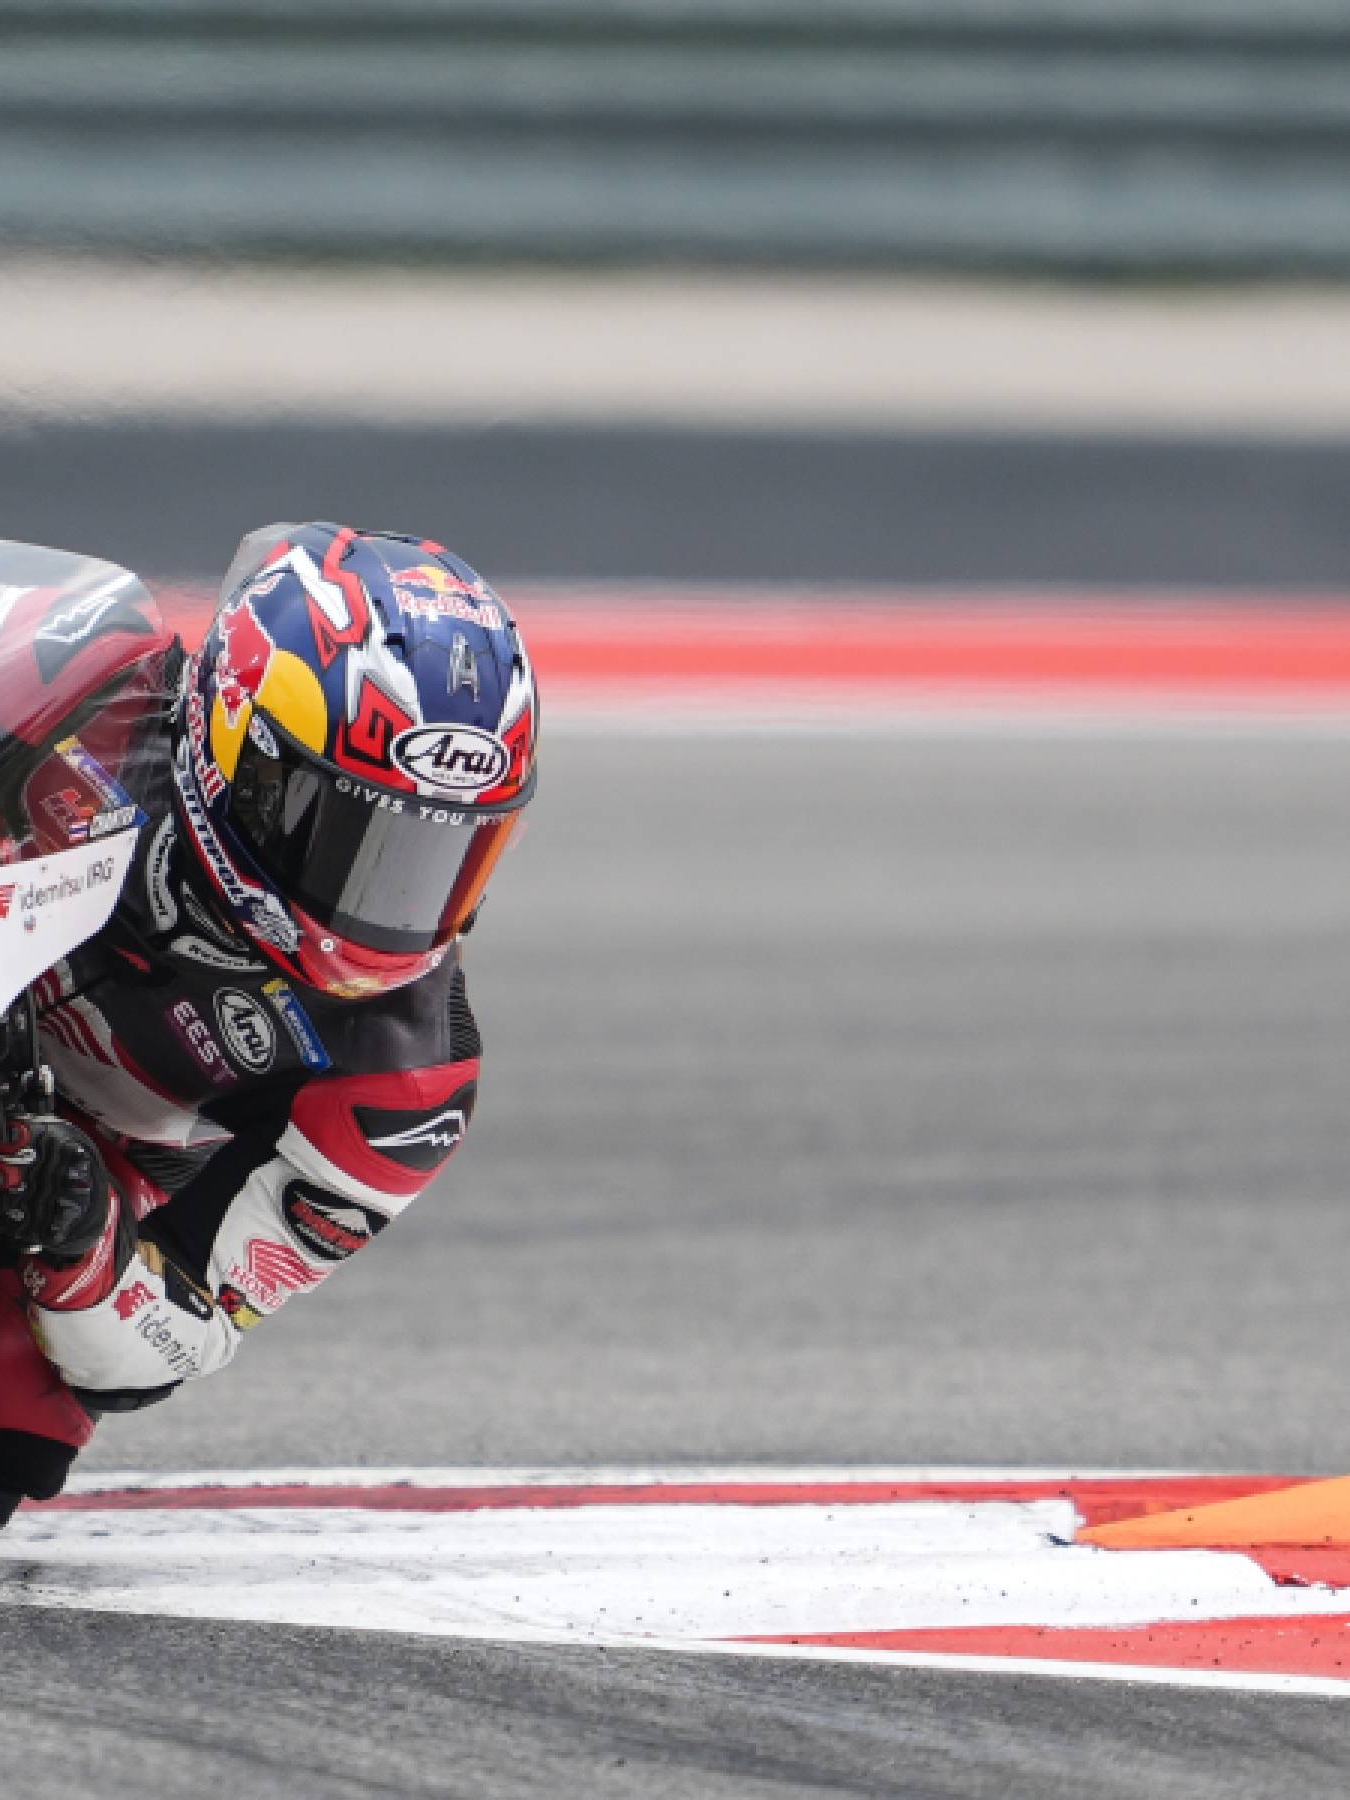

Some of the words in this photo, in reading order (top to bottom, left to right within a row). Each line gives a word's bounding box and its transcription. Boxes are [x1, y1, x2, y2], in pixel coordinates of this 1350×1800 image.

[404, 734, 498, 777] Arai
[335, 777, 405, 814] GIVES
[418, 806, 466, 829] YOU
[19, 873, 84, 910] idemitsu
[87, 857, 116, 890] IRG
[223, 1001, 270, 1060] Arai
[230, 1264, 284, 1309] HOND
